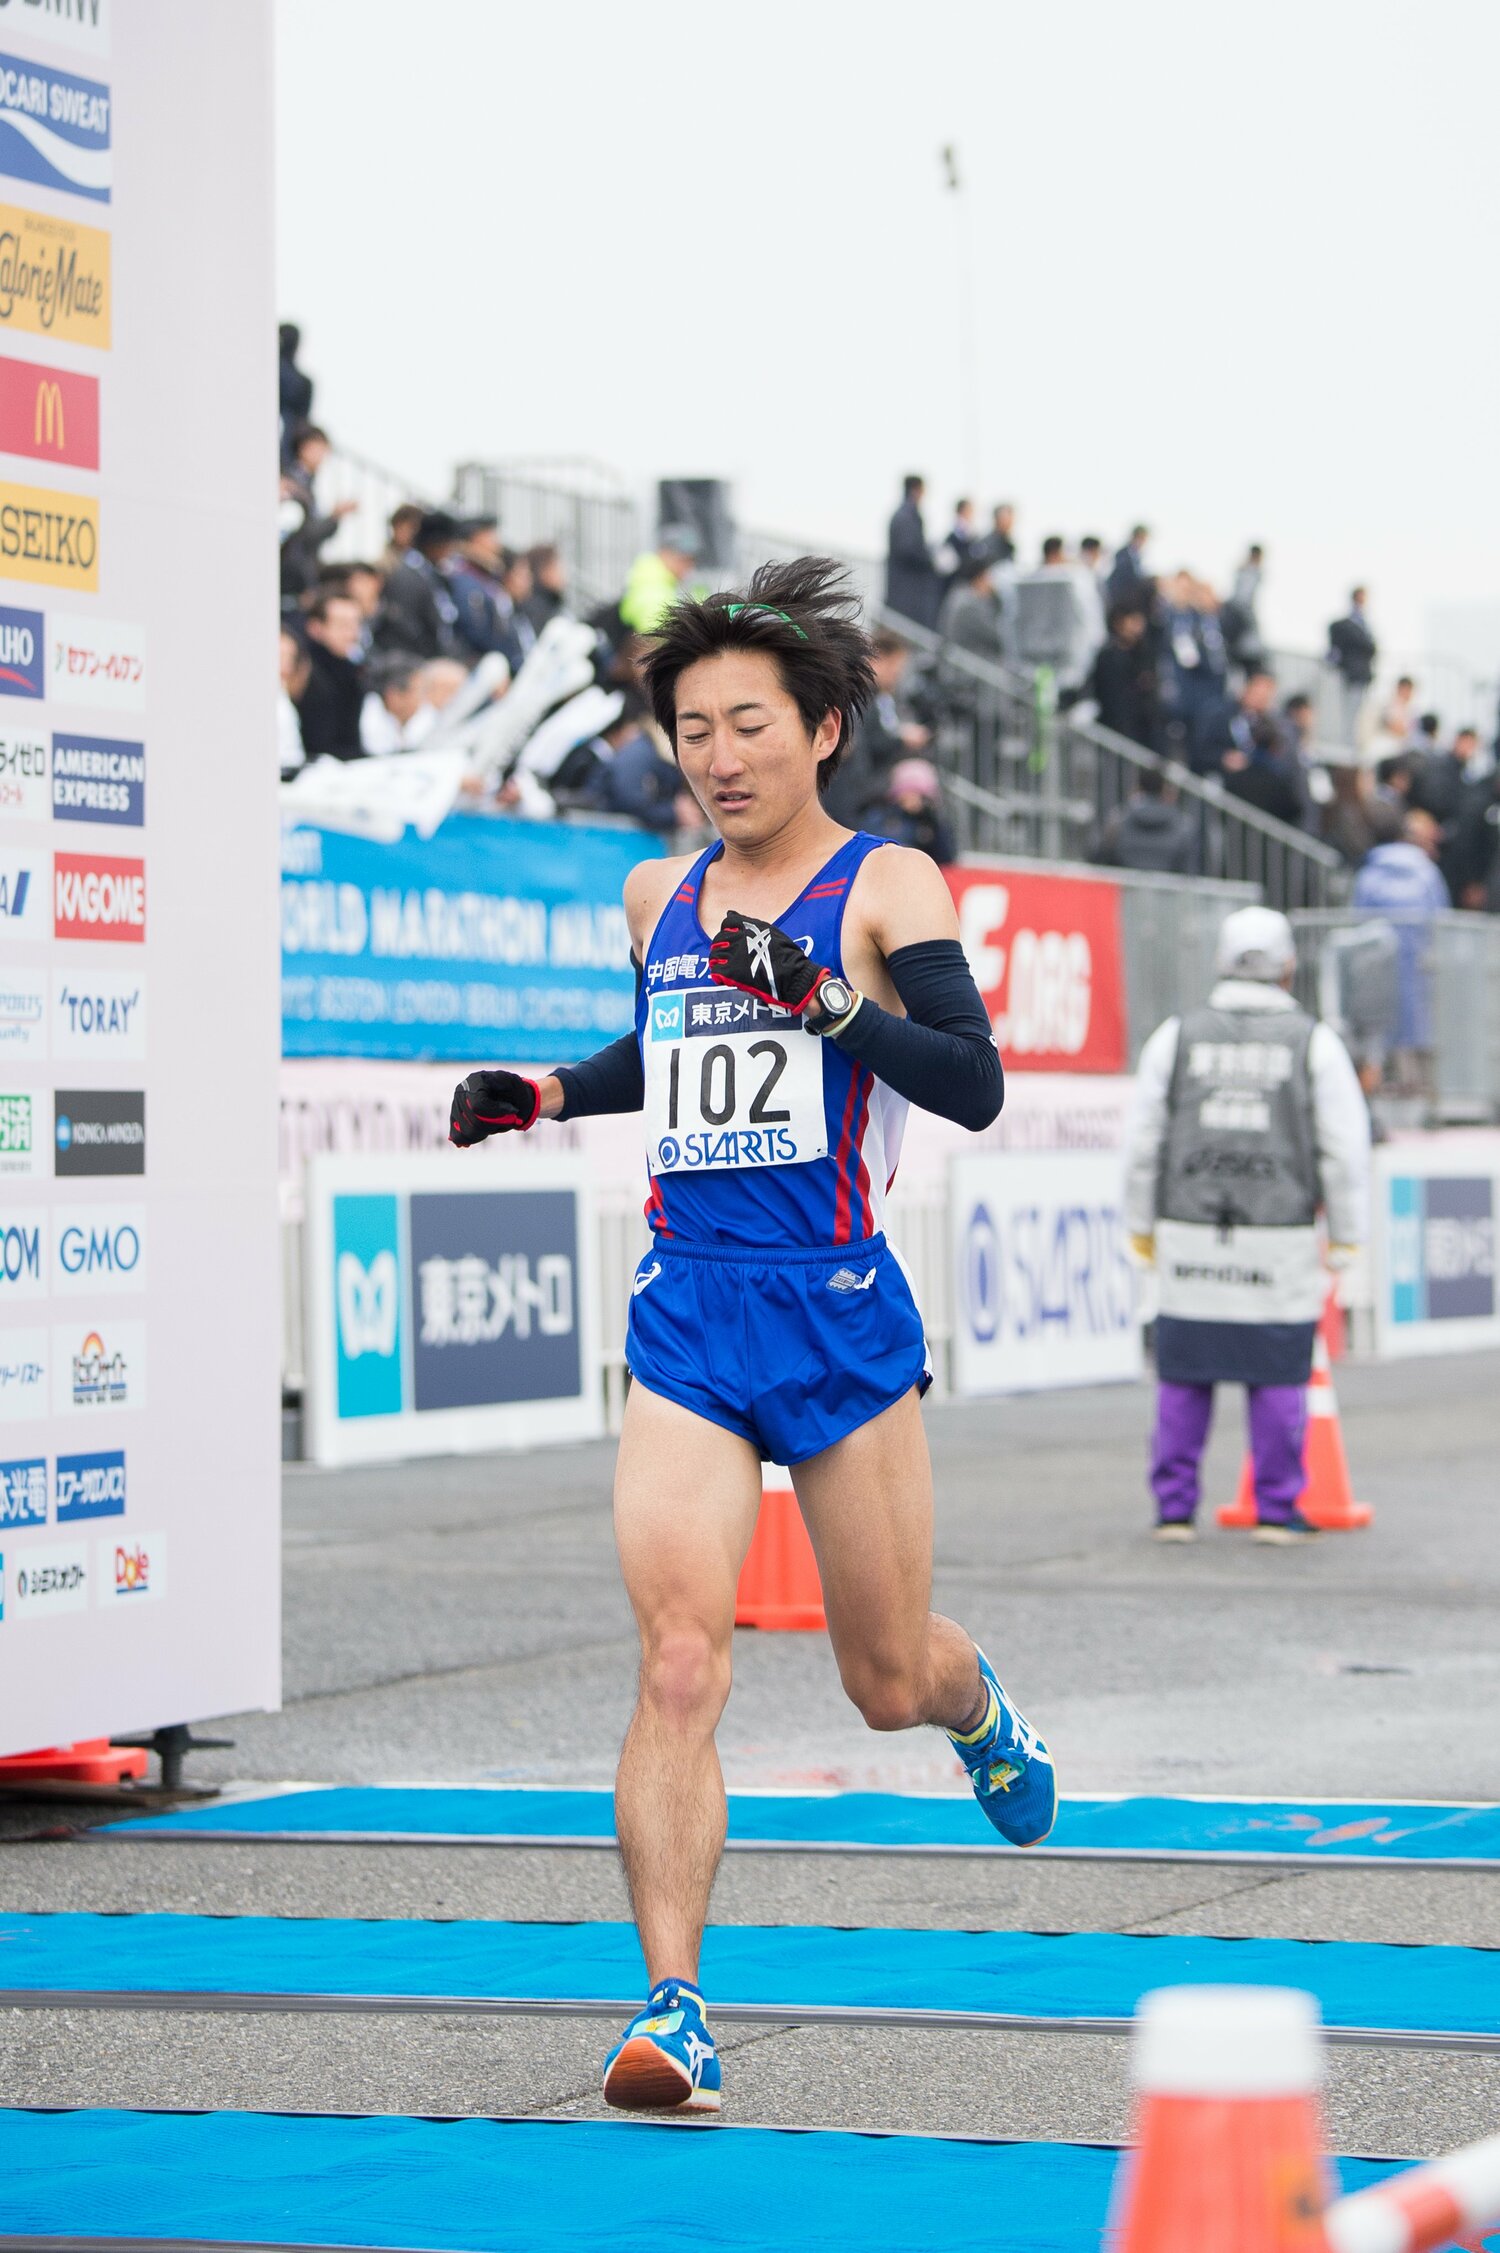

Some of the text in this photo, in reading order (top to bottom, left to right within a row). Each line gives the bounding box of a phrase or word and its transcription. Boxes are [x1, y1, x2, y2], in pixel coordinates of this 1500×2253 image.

[50, 83, 108, 134] SWEAT
[1, 505, 96, 569] SEIKO
[53, 747, 145, 783] AMERICAN
[54, 778, 130, 812] EXPRESS
[55, 871, 145, 925] KAGOME
[669, 1040, 791, 1129] 102
[684, 1128, 797, 1166] STARTS
[60, 1225, 139, 1274] GMO
